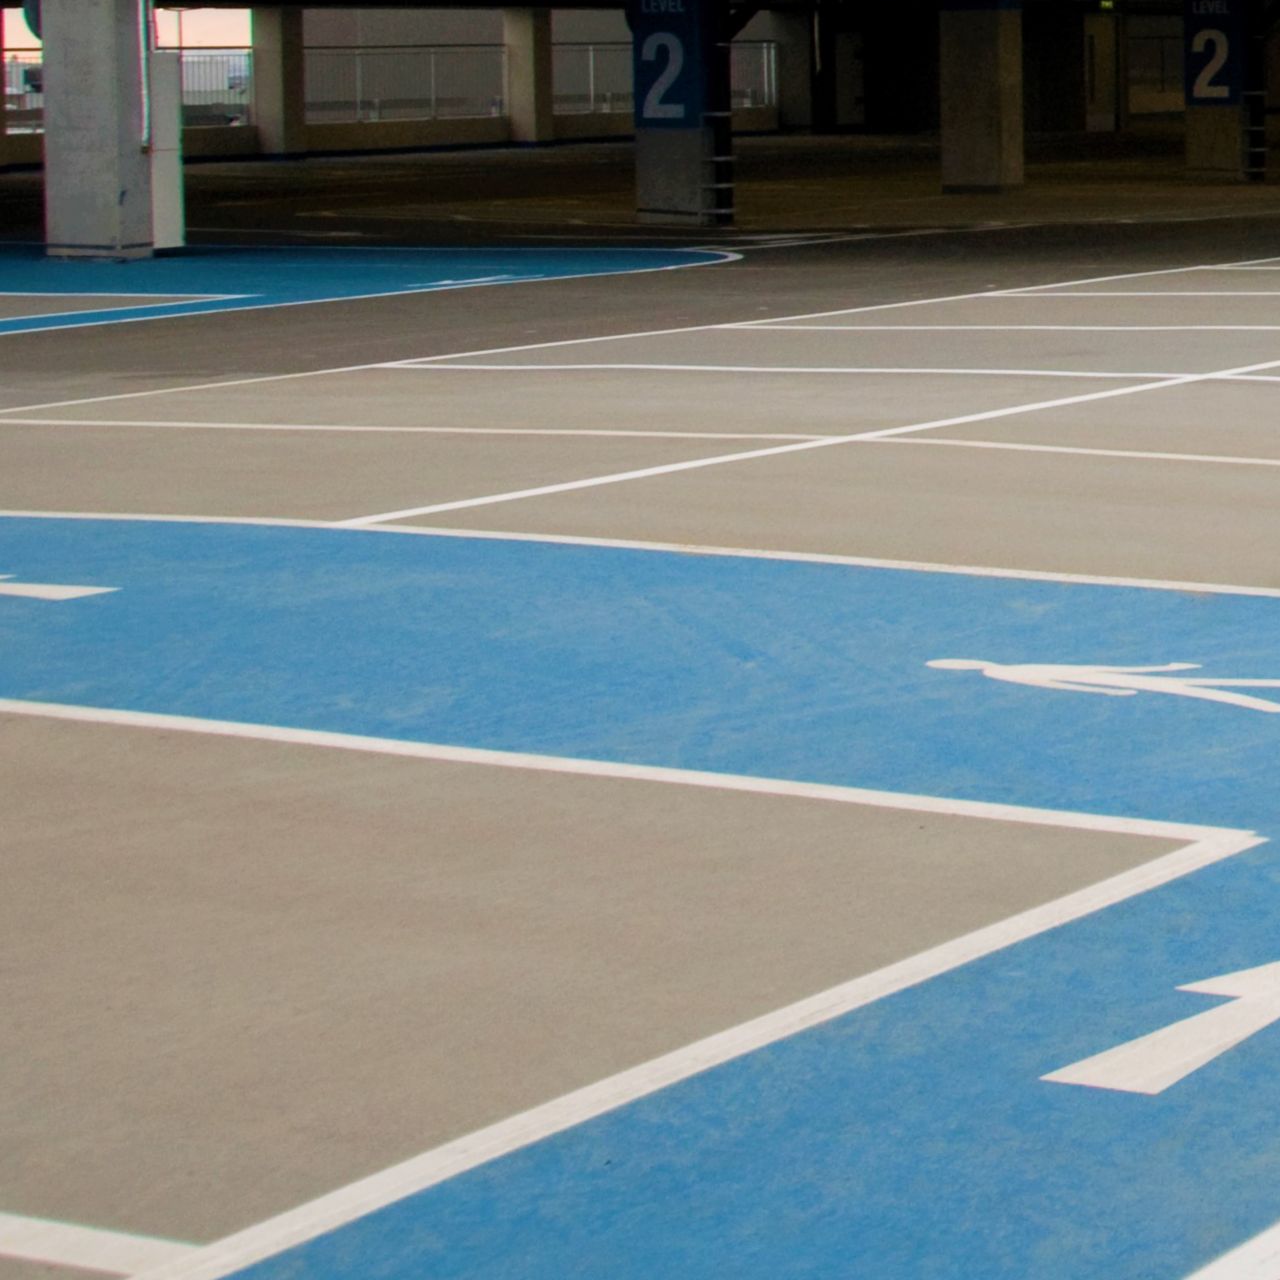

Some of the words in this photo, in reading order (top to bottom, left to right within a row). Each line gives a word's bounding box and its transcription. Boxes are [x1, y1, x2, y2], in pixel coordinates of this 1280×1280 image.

[1192, 0, 1230, 15] LEVEL
[641, 32, 685, 118] 2
[1192, 29, 1230, 98] 2
